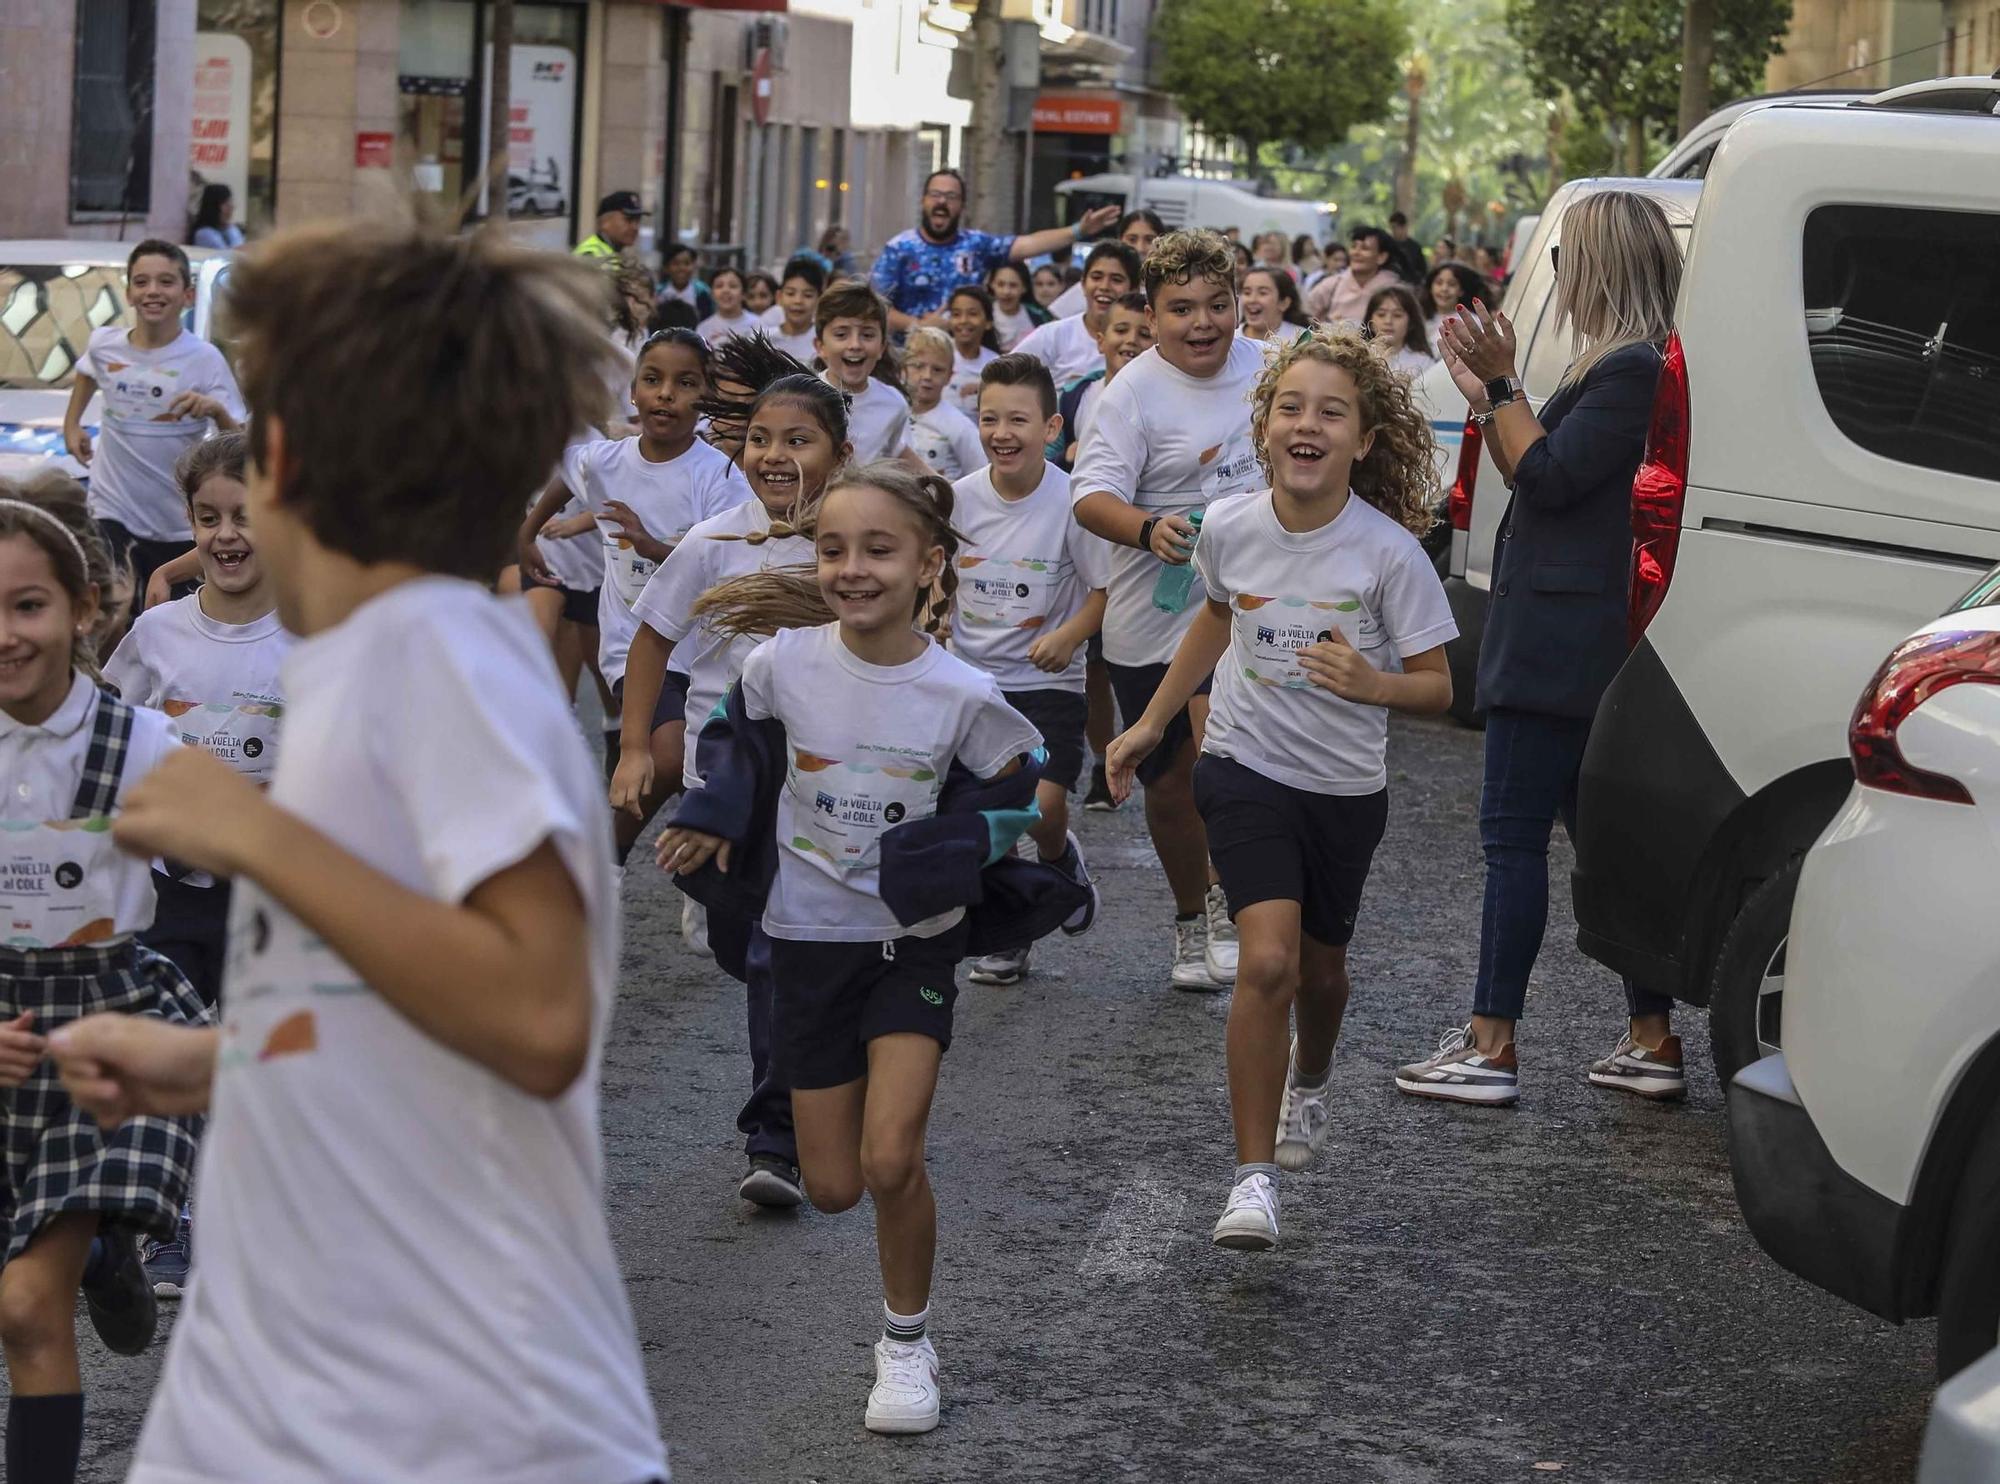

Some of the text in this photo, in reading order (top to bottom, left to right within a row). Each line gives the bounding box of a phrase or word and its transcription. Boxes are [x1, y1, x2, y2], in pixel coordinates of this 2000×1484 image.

[1278, 628, 1315, 640] la VUELTA
[1282, 640, 1290, 649] al
[202, 735, 241, 748] la VUELTA
[215, 747, 236, 758] COLE
[839, 797, 882, 812] la VUELTA
[842, 811, 851, 820] al
[852, 811, 876, 823] COLE
[0, 862, 51, 875] a VUELTA
[3, 878, 44, 890] al COLE
